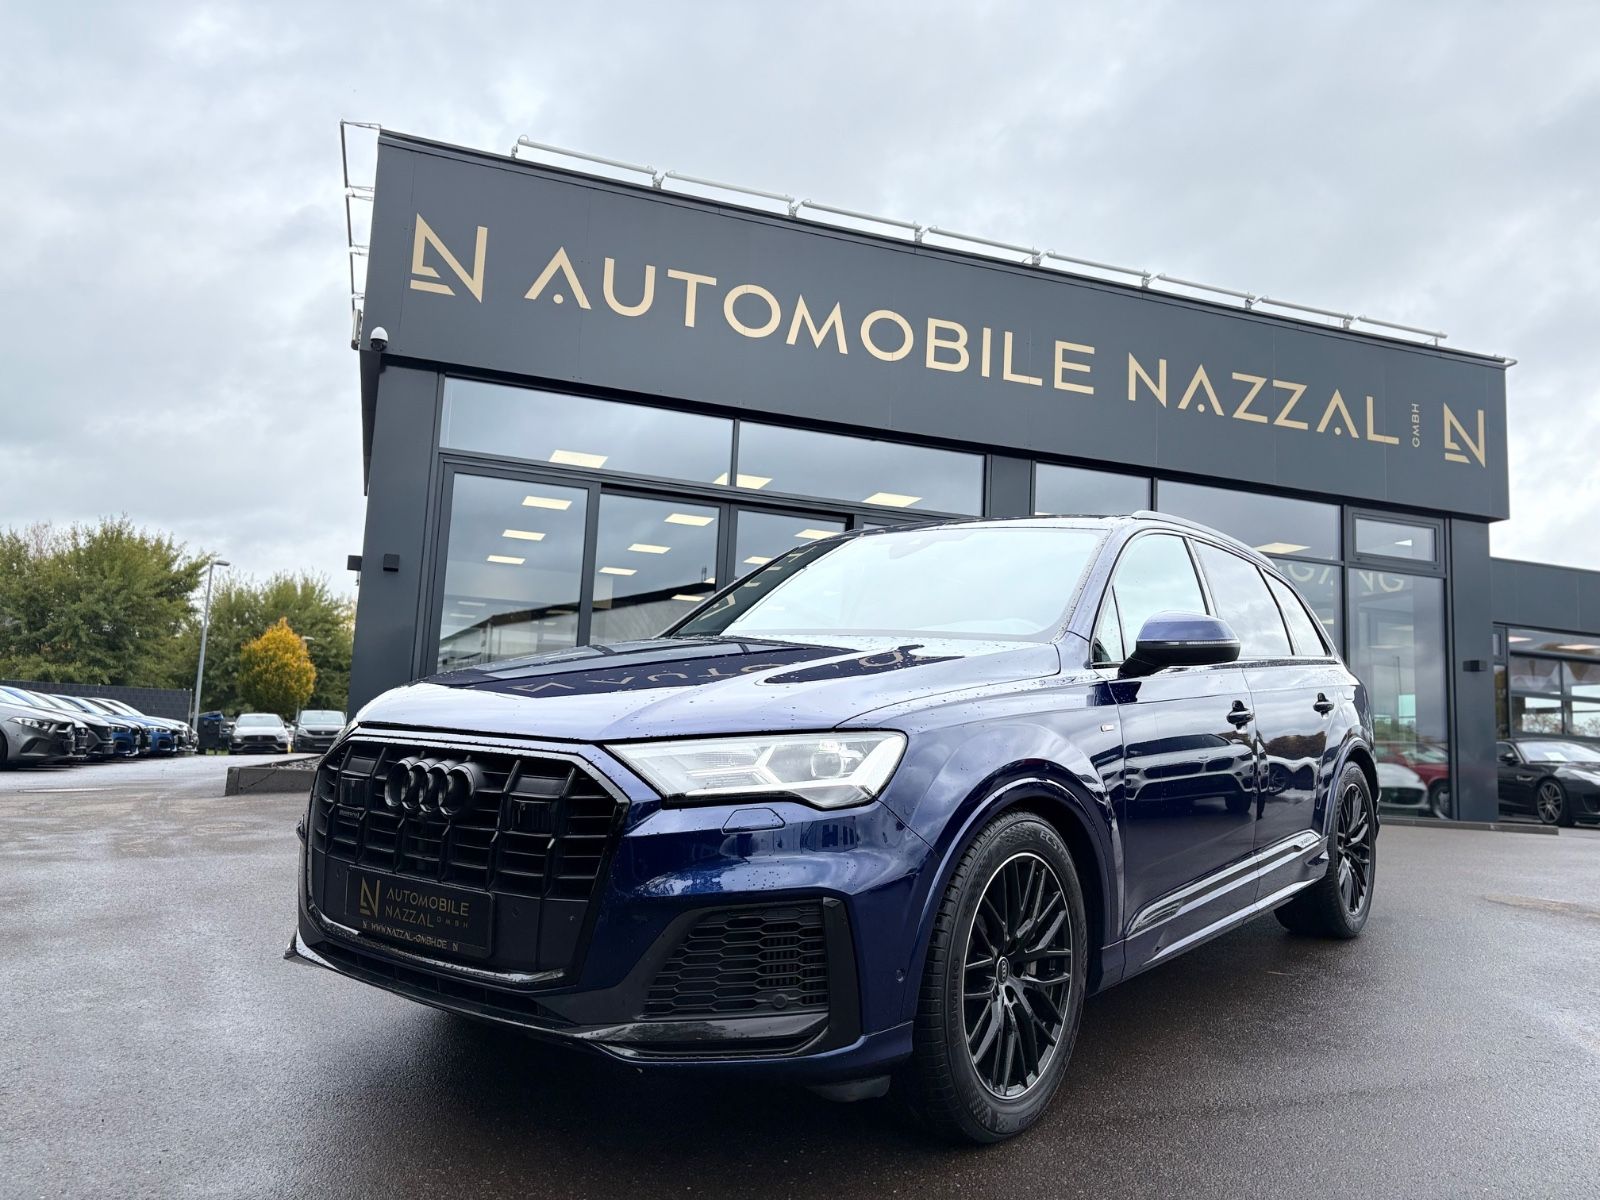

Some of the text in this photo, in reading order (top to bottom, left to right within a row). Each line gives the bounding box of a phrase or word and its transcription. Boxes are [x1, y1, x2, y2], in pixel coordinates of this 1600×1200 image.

[524, 246, 1096, 395] AUTOMOBILE
[1127, 352, 1400, 446] NAZZAL
[1411, 402, 1421, 448] GMBH
[385, 905, 434, 928] NAZZAL
[387, 888, 469, 917] AUTOMOBILE
